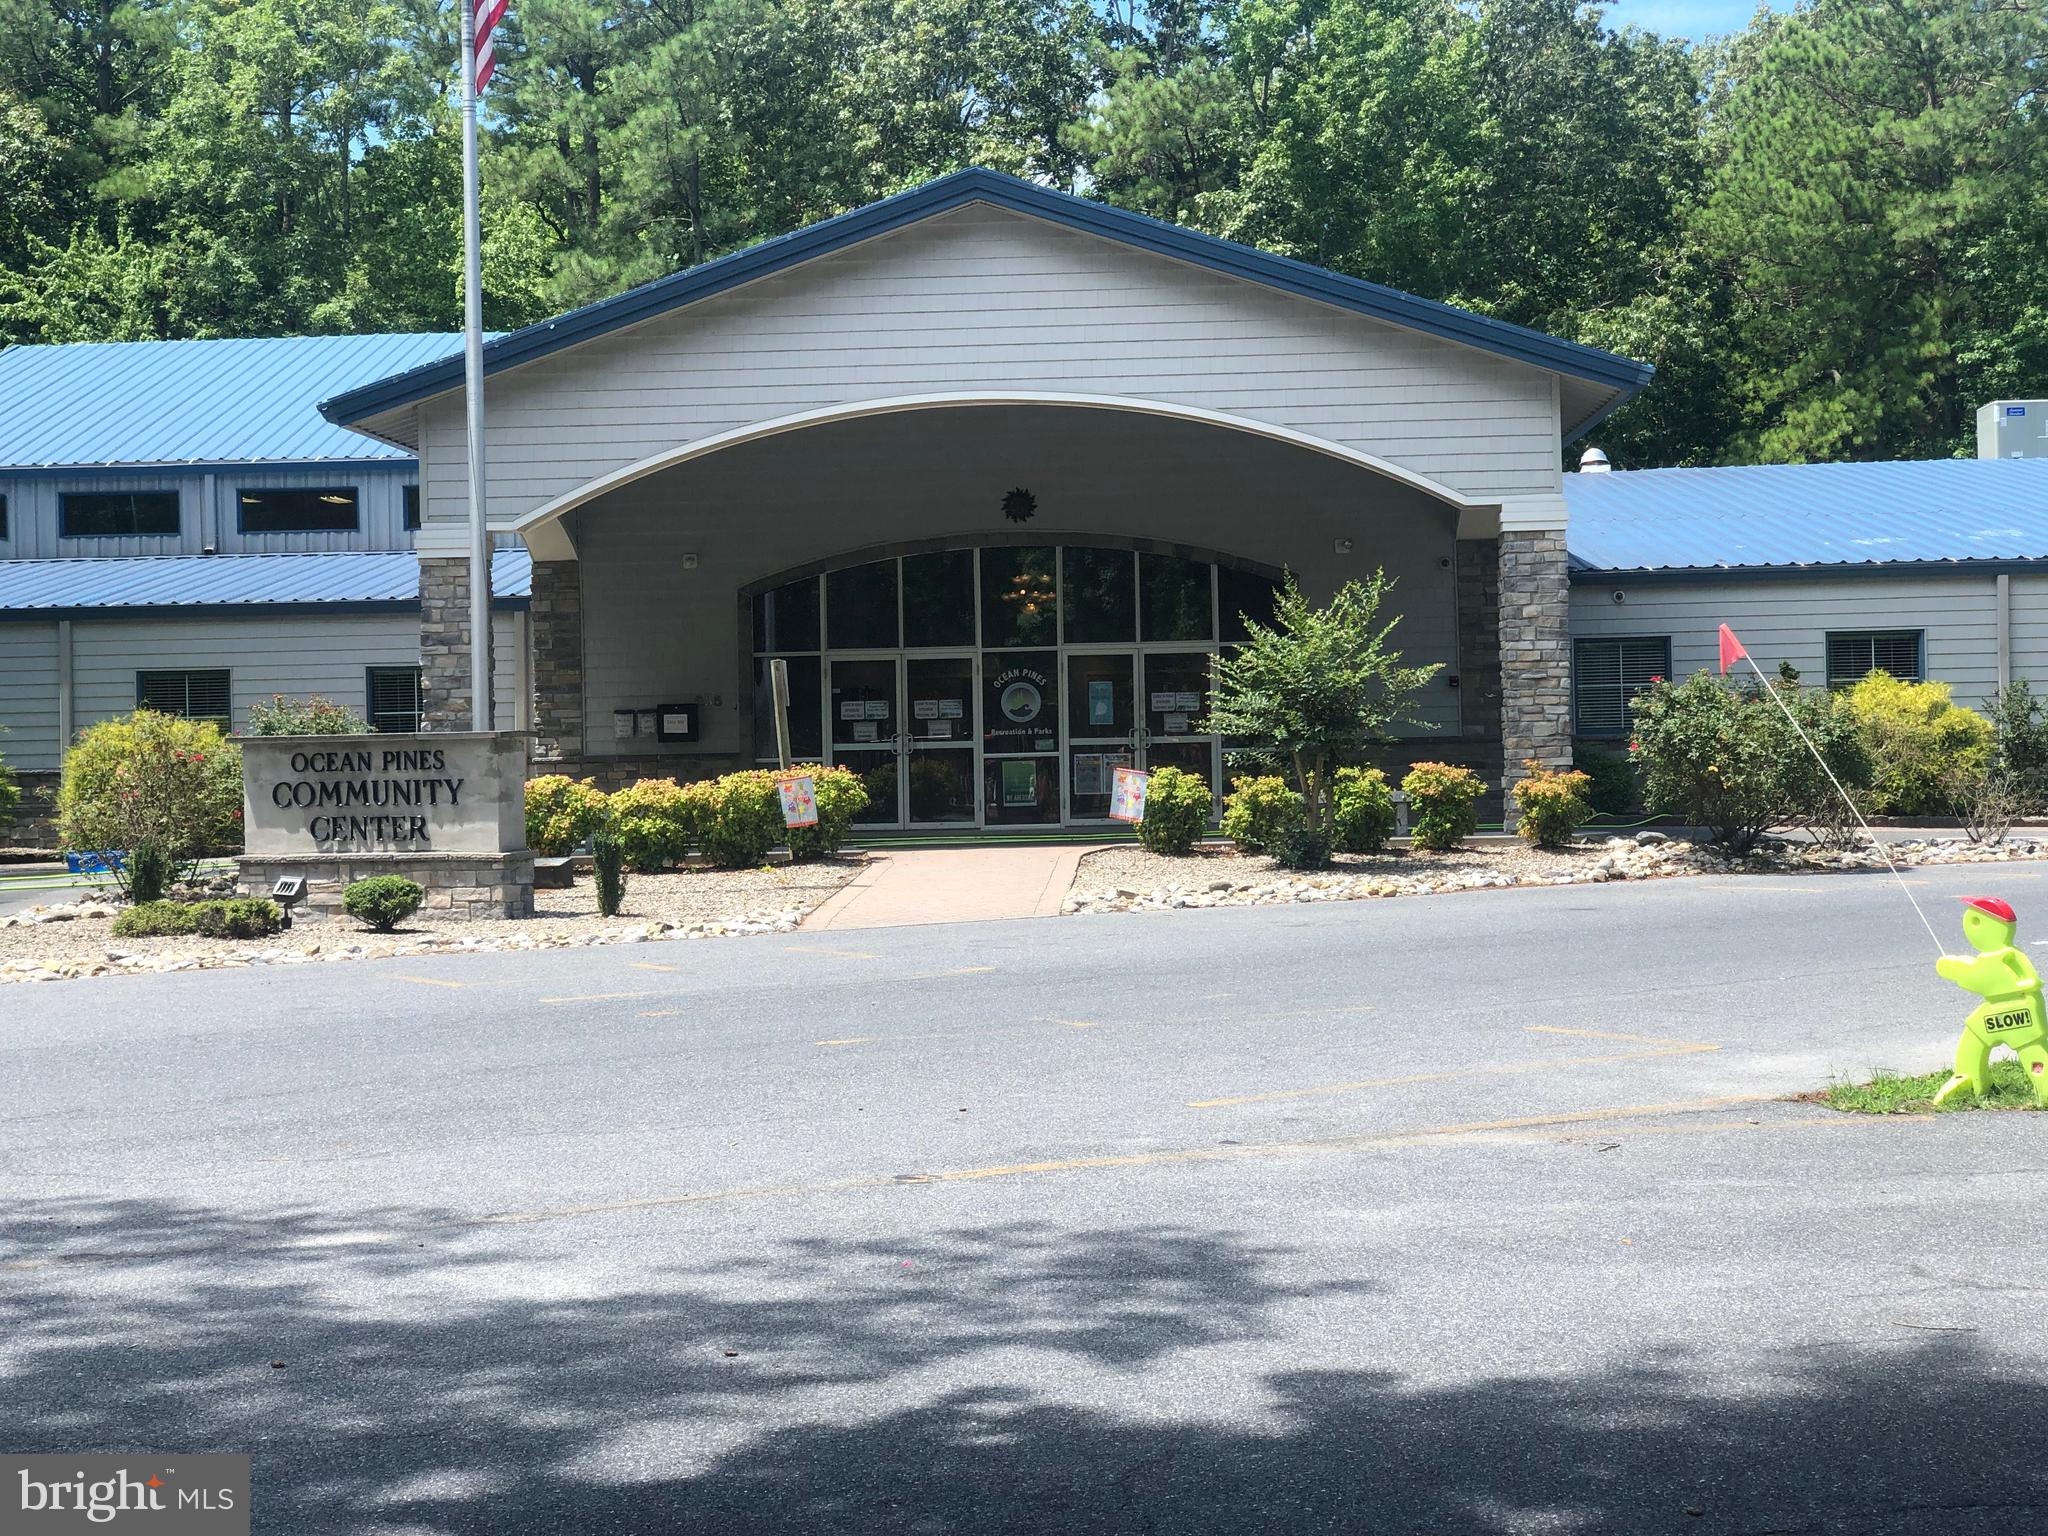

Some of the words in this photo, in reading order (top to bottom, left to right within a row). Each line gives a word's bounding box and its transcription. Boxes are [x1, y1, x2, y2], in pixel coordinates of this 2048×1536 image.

[993, 668, 1020, 688] OCEAN
[1022, 668, 1047, 686] PINES
[991, 728, 1026, 736] Recreation
[1027, 727, 1033, 735] &
[1034, 727, 1053, 735] Parks
[291, 752, 372, 773] OCEAN
[382, 750, 445, 771] PINES
[272, 778, 465, 808] COMMUNITY
[310, 815, 431, 842] CENTER
[1986, 1011, 2030, 1030] SLOW!
